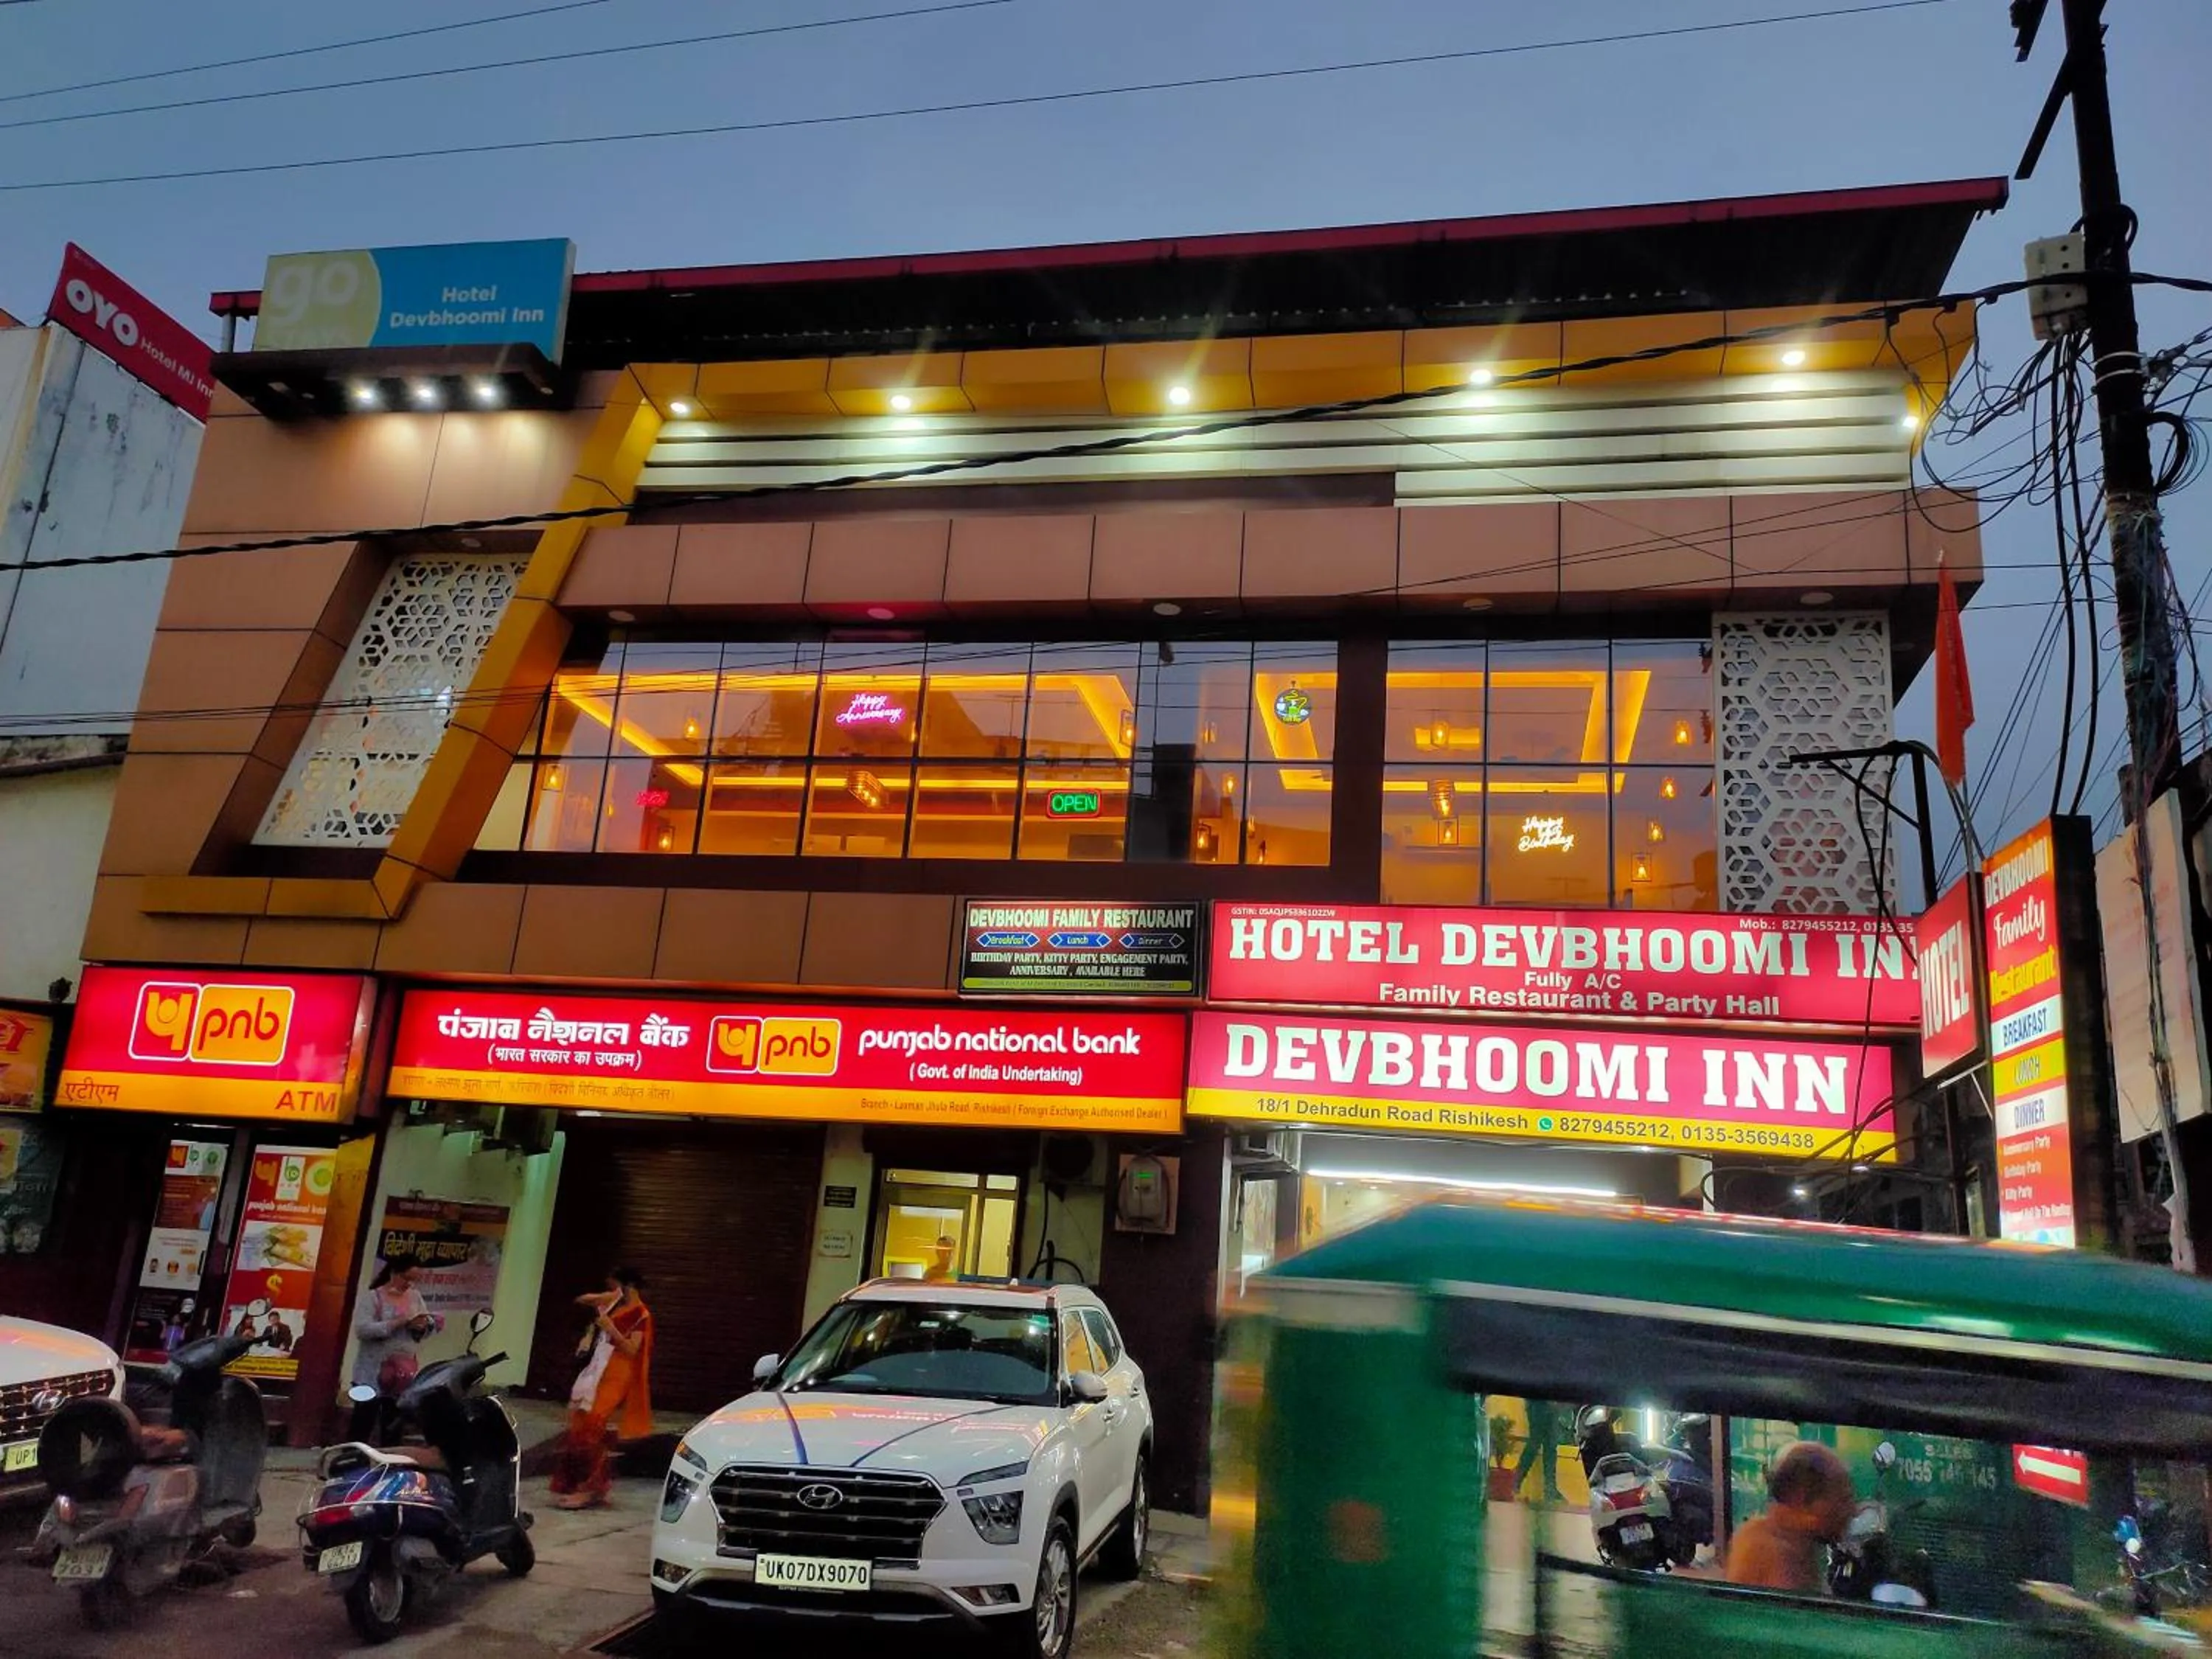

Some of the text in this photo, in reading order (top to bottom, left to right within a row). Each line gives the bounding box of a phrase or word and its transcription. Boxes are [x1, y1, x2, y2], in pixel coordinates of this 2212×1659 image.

[270, 260, 360, 325] go
[442, 285, 498, 304] Hotel
[66, 279, 139, 347] OYO
[140, 336, 176, 372] Hotel
[390, 307, 544, 328] Devbhoomi Inn
[1051, 793, 1097, 812] OPEN
[1983, 835, 2049, 909] DEVBHOOMI
[970, 908, 1194, 929] DEVBHOOMI FAMILY RESTAURANT
[1782, 920, 1860, 933] 8279455212,
[1993, 894, 2047, 950] Family
[990, 934, 1024, 945] Breakfast
[1067, 936, 1089, 945] Lunch
[1228, 917, 1419, 964] HOTEL
[1441, 922, 1811, 978] DEVBHOOMI
[970, 952, 1013, 963] BIRTHDAY
[1014, 952, 1042, 964] PARTY,
[1099, 953, 1158, 964] ENGAGEMENT
[1158, 953, 1189, 966] PARTY,
[1121, 967, 1146, 977] HERE
[1989, 944, 2056, 1006] Restaurant
[1524, 970, 1621, 992] Fully A/C
[1920, 920, 1969, 1040] HOTEL
[1380, 982, 1779, 1016] Family Restaurant & Party Hall
[198, 996, 280, 1051] pnb
[437, 1006, 692, 1048] पंजाब नैशनल बैंक
[858, 1023, 1141, 1057] punjab national bank
[2003, 1007, 2048, 1048] BREAKFAST
[529, 1048, 570, 1065] सरकार
[574, 1051, 591, 1065] का
[766, 1026, 831, 1062] pnb
[953, 1064, 967, 1079] of
[967, 1063, 999, 1082] India
[1002, 1065, 1082, 1085] Undertaking)
[1223, 1023, 1847, 1114] DEVBHOOMI INN
[64, 1077, 120, 1102] एटीएम
[275, 1089, 337, 1113] ATM
[1257, 1098, 1815, 1150] 18/1 Dehradun Road Rishikesh 8279455212, 0135-3569438
[2014, 1097, 2045, 1130] DINNER
[765, 1559, 868, 1585] UK07DX9070
